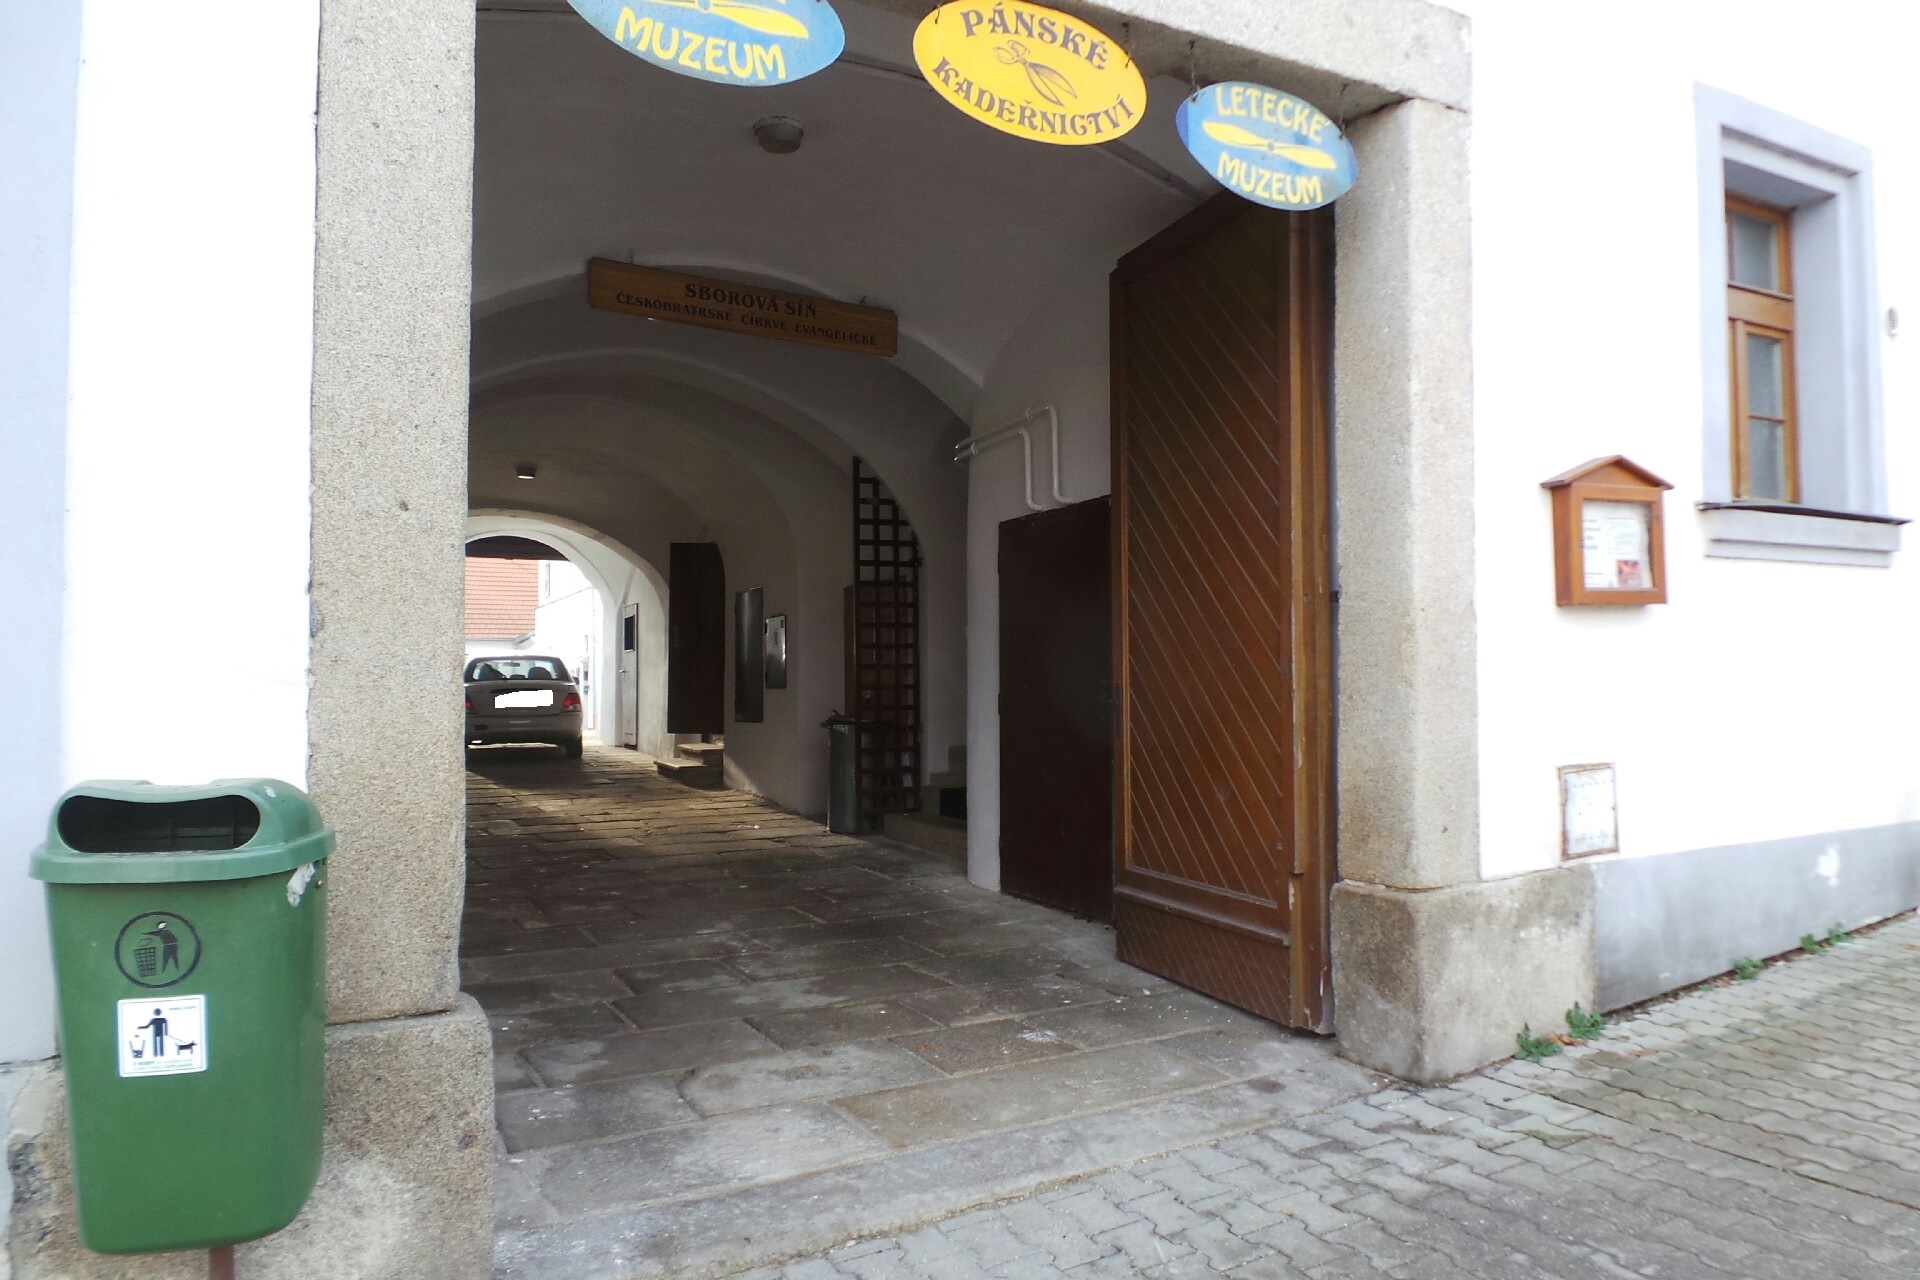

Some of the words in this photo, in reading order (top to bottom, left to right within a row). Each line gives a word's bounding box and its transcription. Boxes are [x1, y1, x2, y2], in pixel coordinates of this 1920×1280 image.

[614, 6, 786, 80] MUZEUM
[960, 1, 1109, 70] PÁNSKÉ
[932, 56, 1134, 136] KADEŘNICTVÍ
[1216, 85, 1332, 143] LETECKÉ
[1217, 151, 1323, 204] MUZEUM
[684, 282, 778, 313] SBOROVÁ
[741, 313, 788, 331] CÍRKVE
